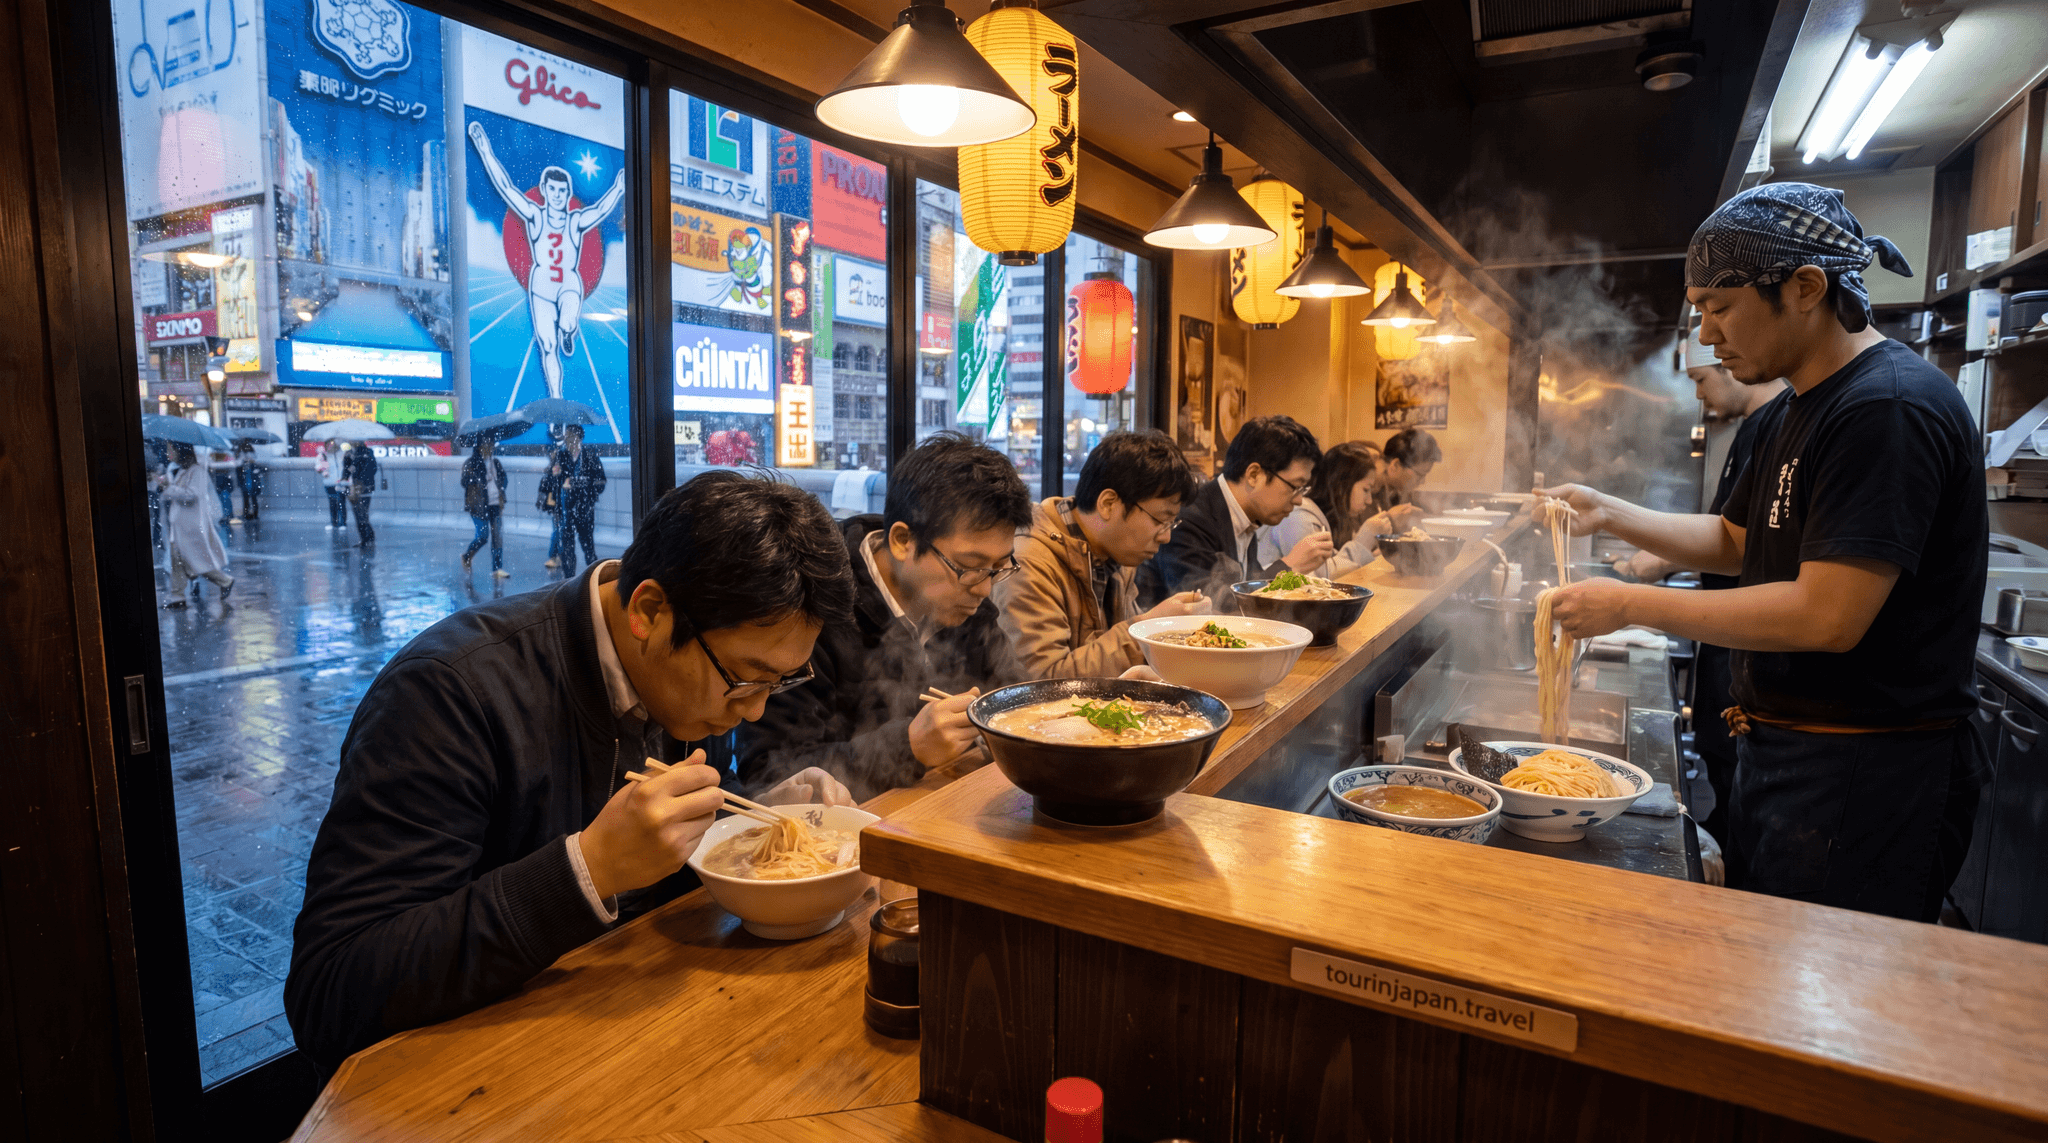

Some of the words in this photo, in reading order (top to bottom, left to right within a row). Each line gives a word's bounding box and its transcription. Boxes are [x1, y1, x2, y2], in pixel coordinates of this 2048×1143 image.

[504, 58, 602, 106] Glico
[1039, 42, 1078, 207] ラーメン
[1325, 964, 1535, 1033] tourinjapan.travel
